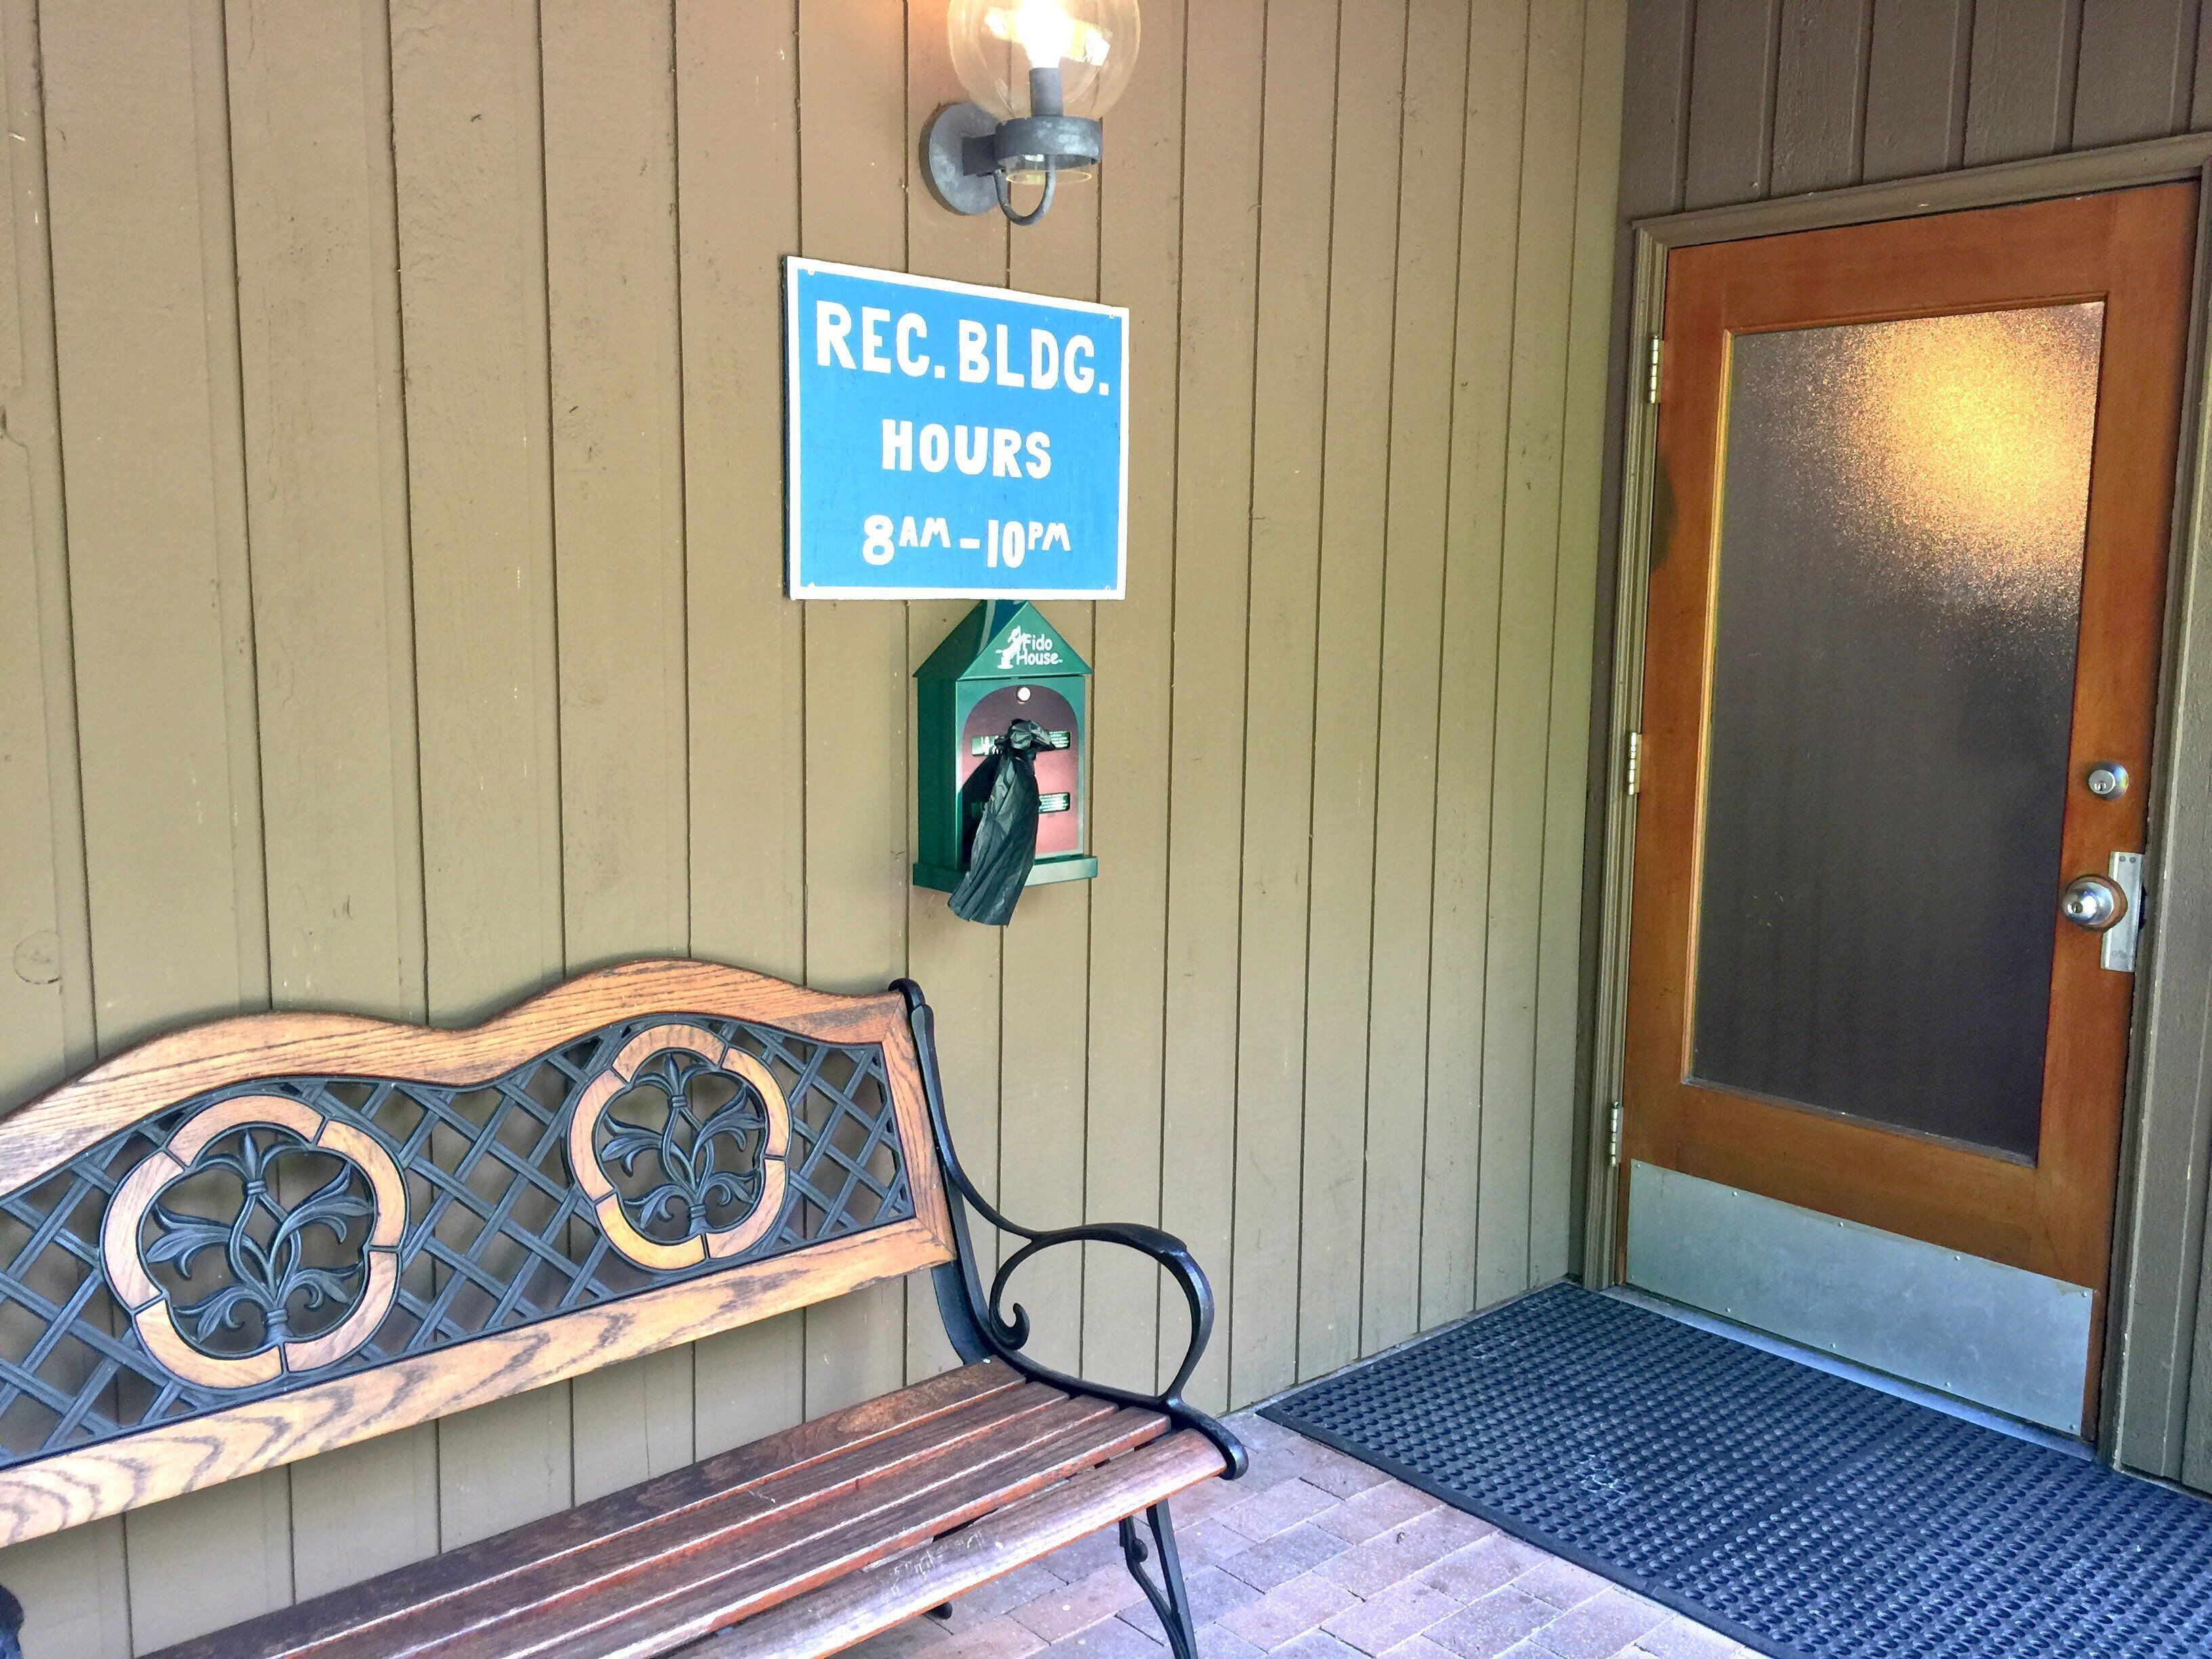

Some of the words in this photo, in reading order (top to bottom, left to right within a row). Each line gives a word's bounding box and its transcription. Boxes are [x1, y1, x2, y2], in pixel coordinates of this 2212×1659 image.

[816, 300, 946, 380] REC.
[958, 319, 1110, 396] BLDG.
[882, 418, 1052, 479] HOURS
[1016, 648, 1060, 665] House
[1022, 632, 1053, 651] Fido
